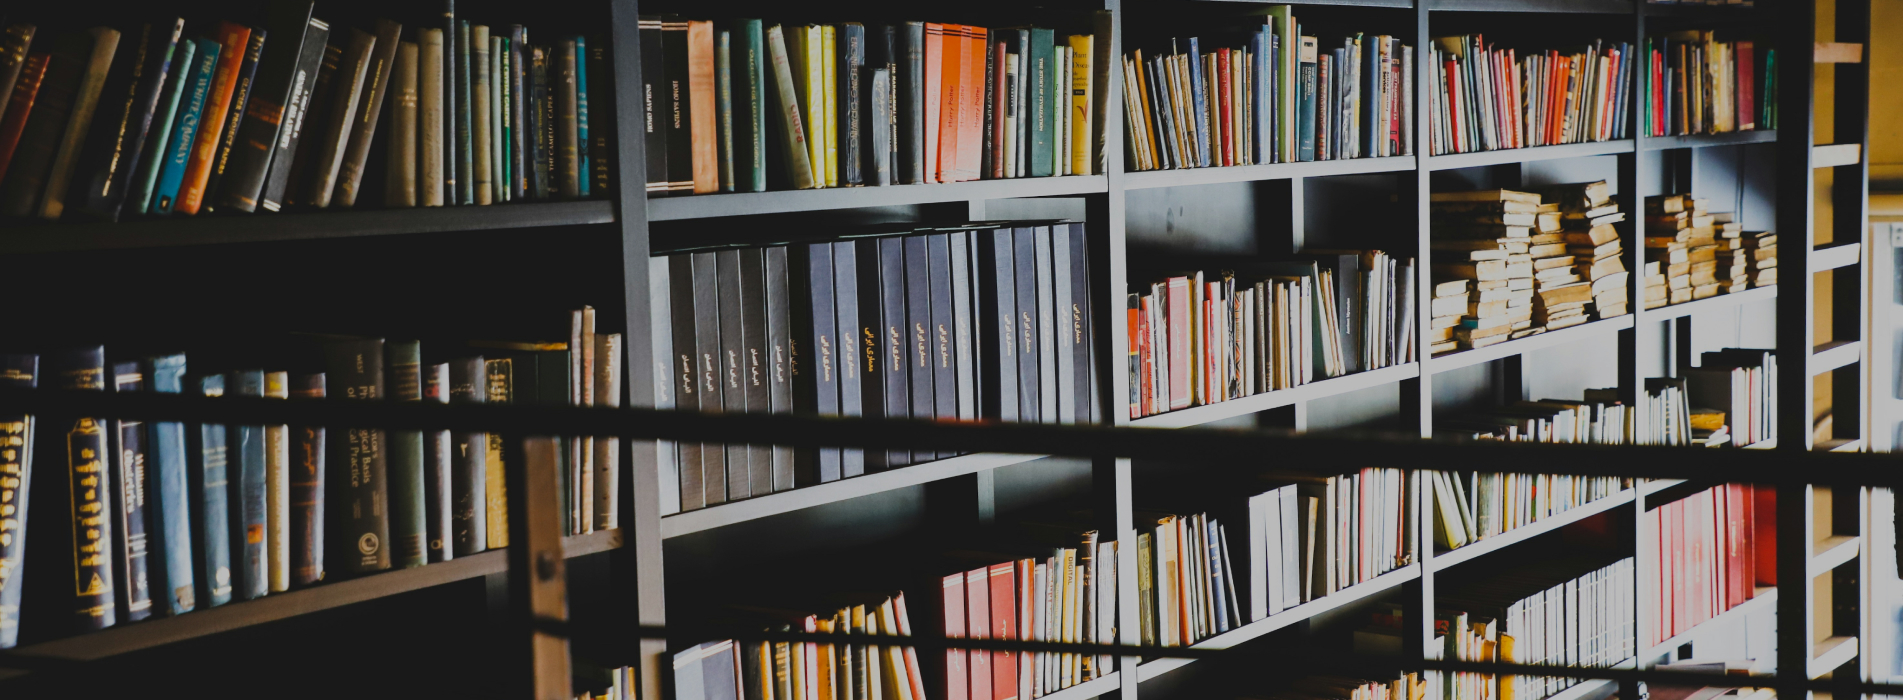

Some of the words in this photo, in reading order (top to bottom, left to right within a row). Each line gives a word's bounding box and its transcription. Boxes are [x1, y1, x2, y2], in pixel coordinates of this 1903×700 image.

[201, 55, 214, 74] THE
[190, 79, 209, 114] WHITE
[235, 78, 250, 111] GLACIER
[292, 70, 307, 104] GENERAL
[645, 83, 653, 111] SAPIENS
[280, 104, 298, 149] RELATIVITY
[673, 101, 681, 129] SAPIENS
[790, 104, 803, 143] RADIO
[175, 113, 198, 167] COMPANY
[225, 112, 240, 146] PROJECT
[218, 147, 231, 175] PAPERS
[1004, 314, 1012, 332] ایرانی
[1023, 312, 1031, 329] ایرانی
[1073, 304, 1081, 320] ایرانی
[820, 335, 830, 354] ایرانی
[864, 327, 875, 346] ایرانی
[890, 327, 899, 345] ایرانی
[916, 323, 925, 341] ایرانی
[938, 324, 948, 342] ایرانی
[1024, 330, 1032, 353] معماری
[1074, 322, 1082, 344] معماری
[356, 354, 364, 374] WEST
[866, 347, 875, 372] معماری
[892, 346, 900, 371] معماری
[918, 343, 926, 367] معماری
[823, 356, 831, 382] معماری
[350, 447, 361, 488] Practice
[363, 457, 371, 484] Basis
[124, 449, 136, 514] Obstetrics
